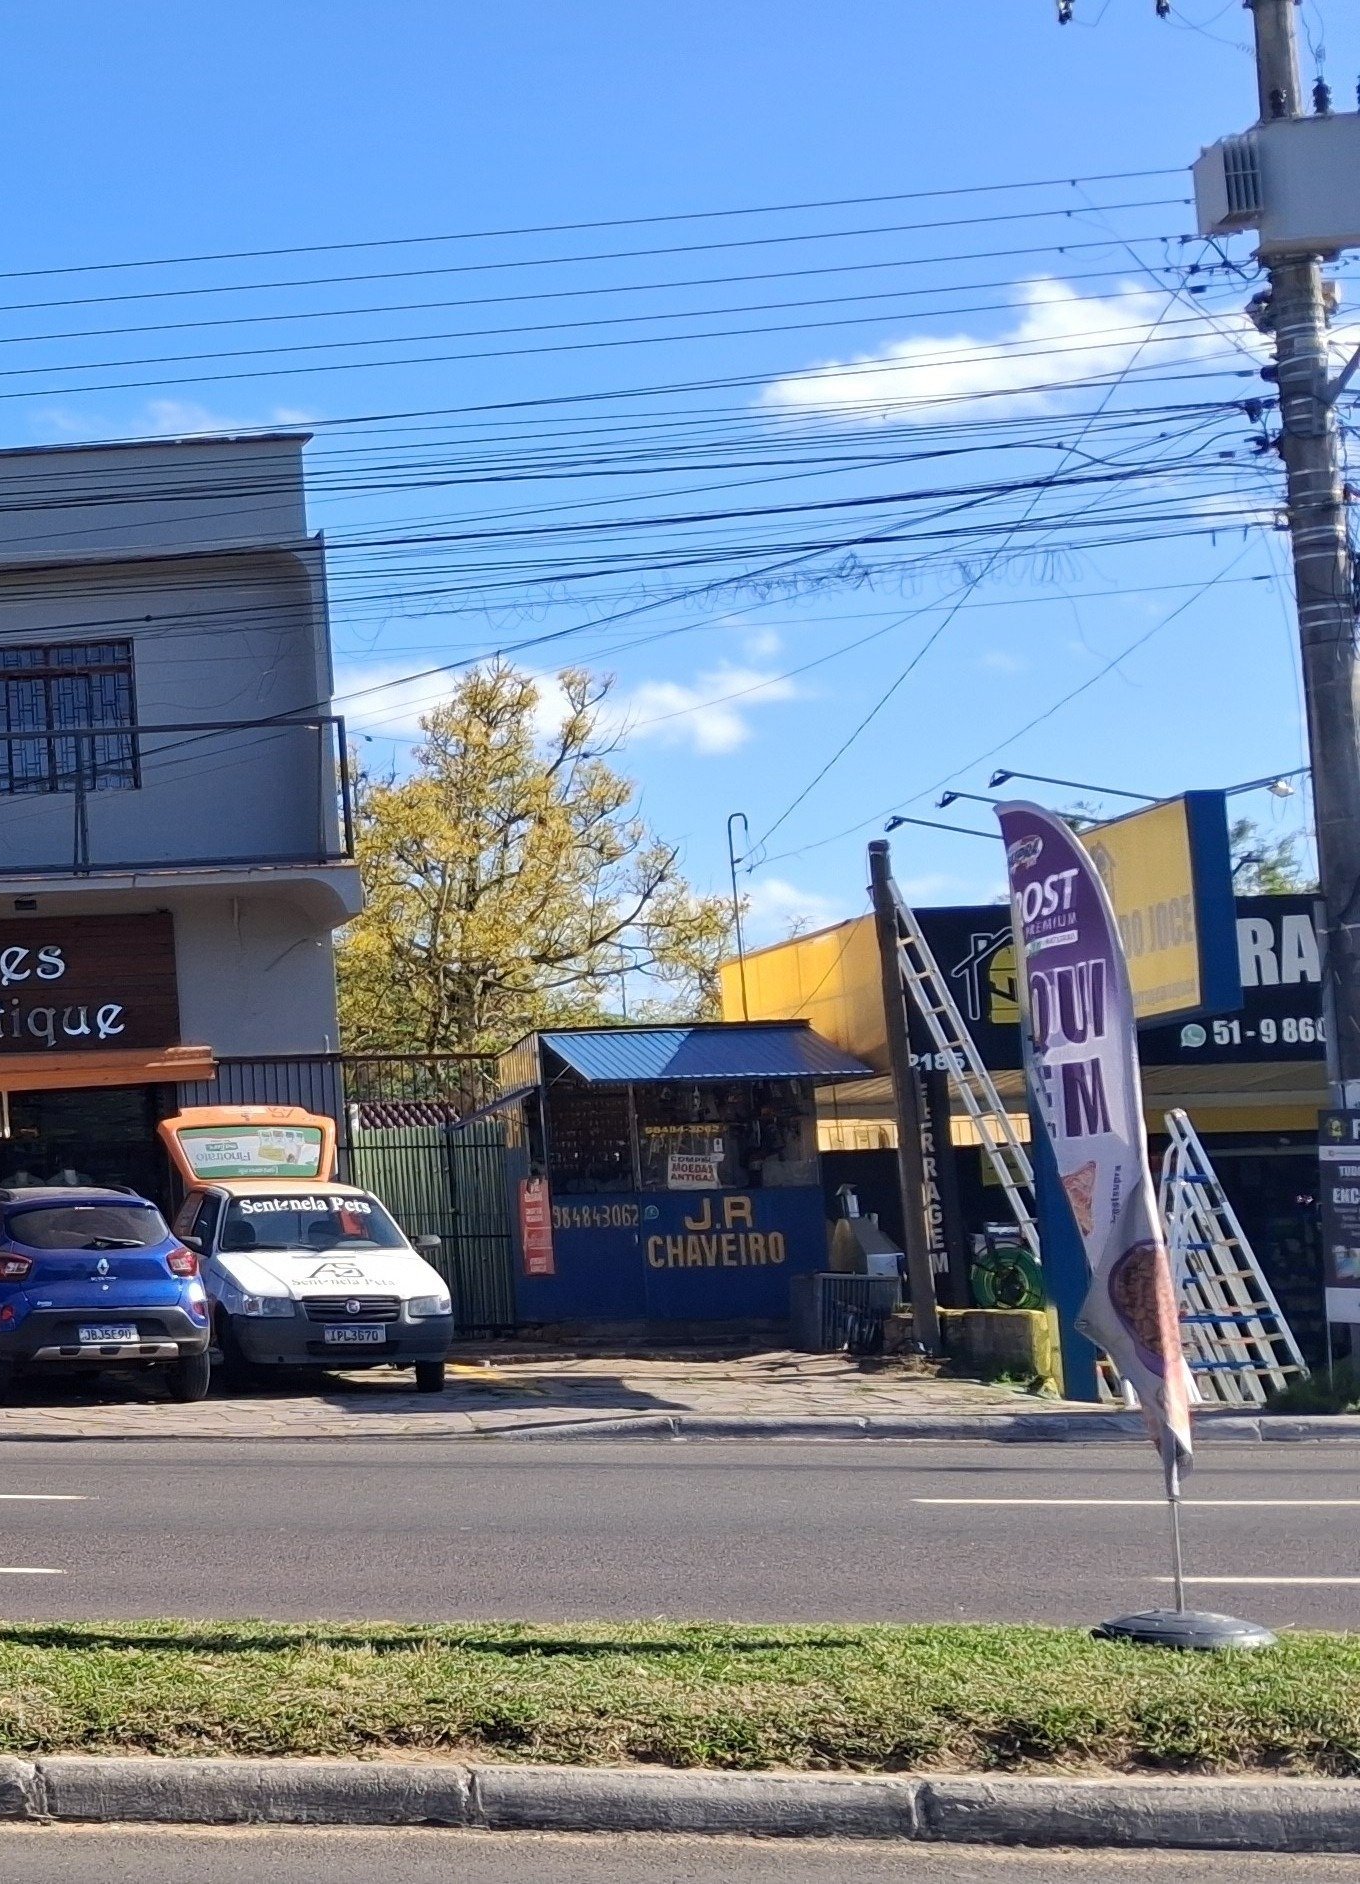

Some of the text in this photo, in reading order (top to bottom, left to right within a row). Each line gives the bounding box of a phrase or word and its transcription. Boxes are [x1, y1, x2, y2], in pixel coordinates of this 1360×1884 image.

[671, 1163, 714, 1174] MOEDAS
[552, 1203, 640, 1229] 984843062
[647, 1231, 786, 1269] CHAVEIRO
